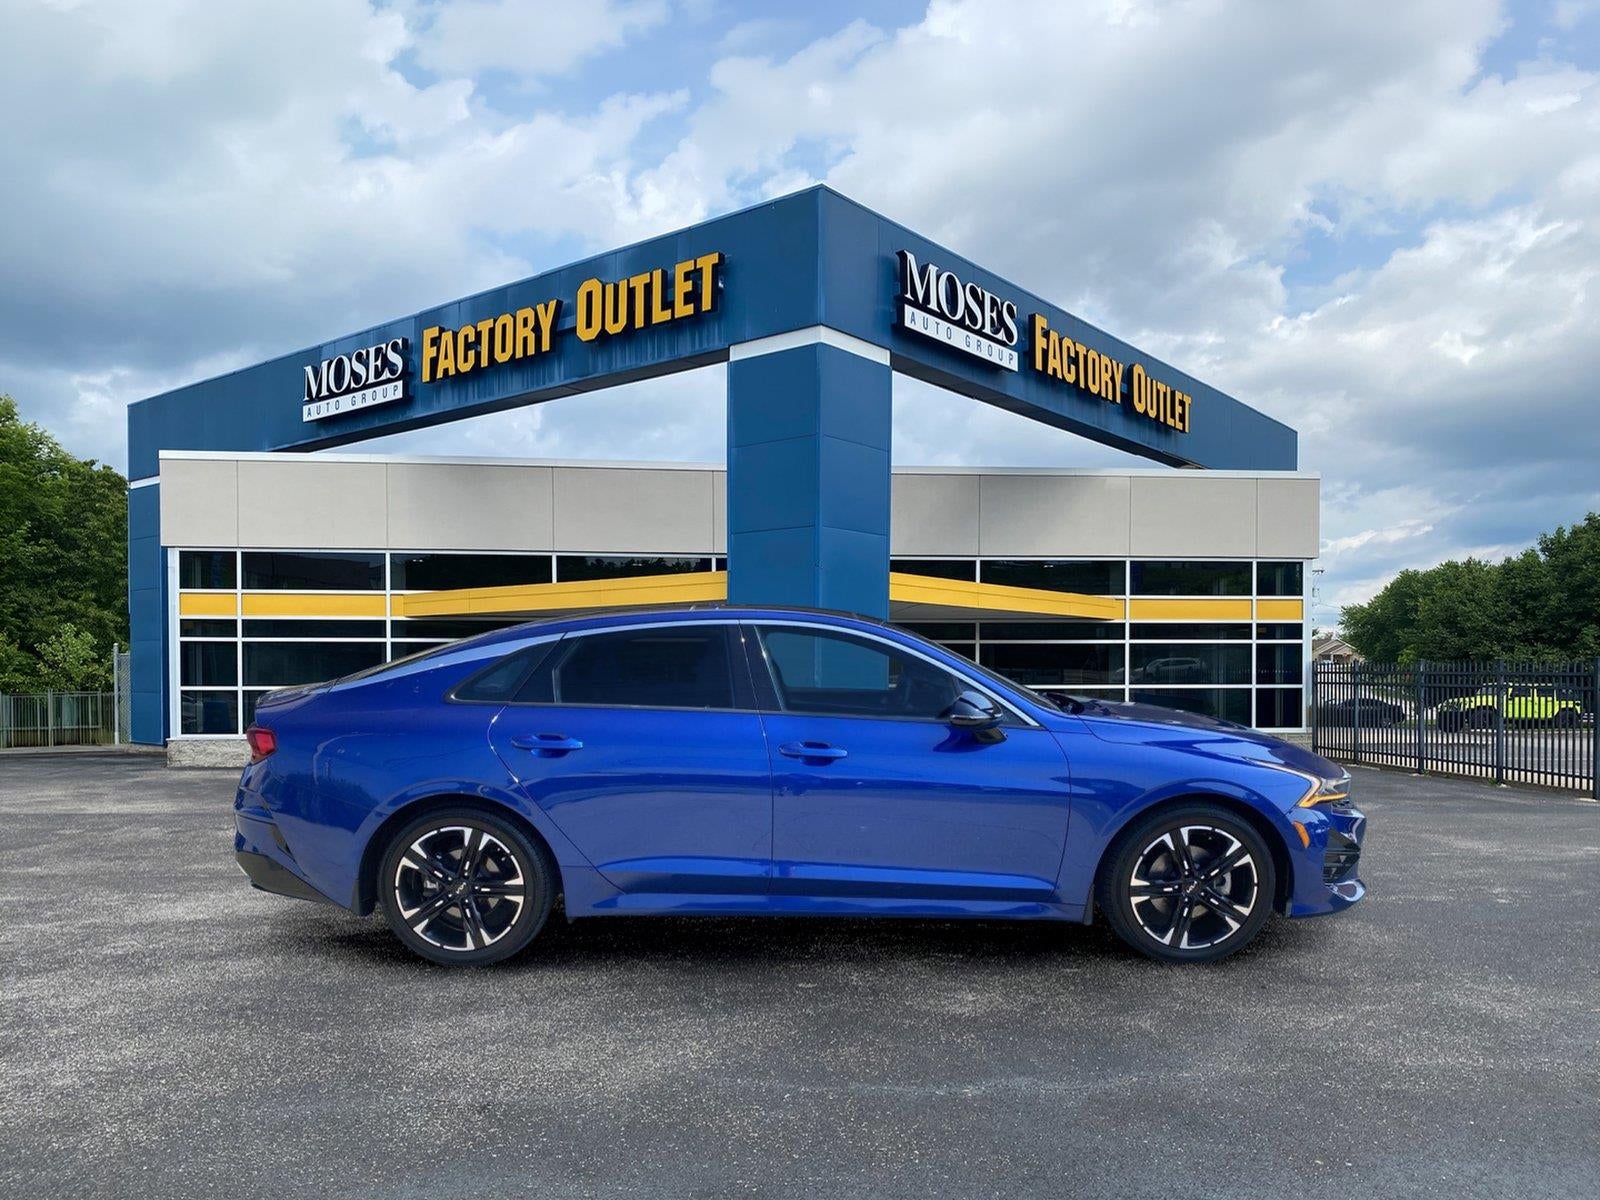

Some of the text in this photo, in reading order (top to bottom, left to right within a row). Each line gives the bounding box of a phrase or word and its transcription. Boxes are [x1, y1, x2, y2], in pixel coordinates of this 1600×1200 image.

[421, 251, 721, 383] FACTORY OUTLET
[903, 249, 1018, 346] MOSES
[303, 338, 403, 402] MOSES
[910, 311, 1014, 365] AUTO GROUP
[1034, 313, 1191, 433] FACTORY OUTLET
[307, 385, 399, 417] AUTO GROUP
